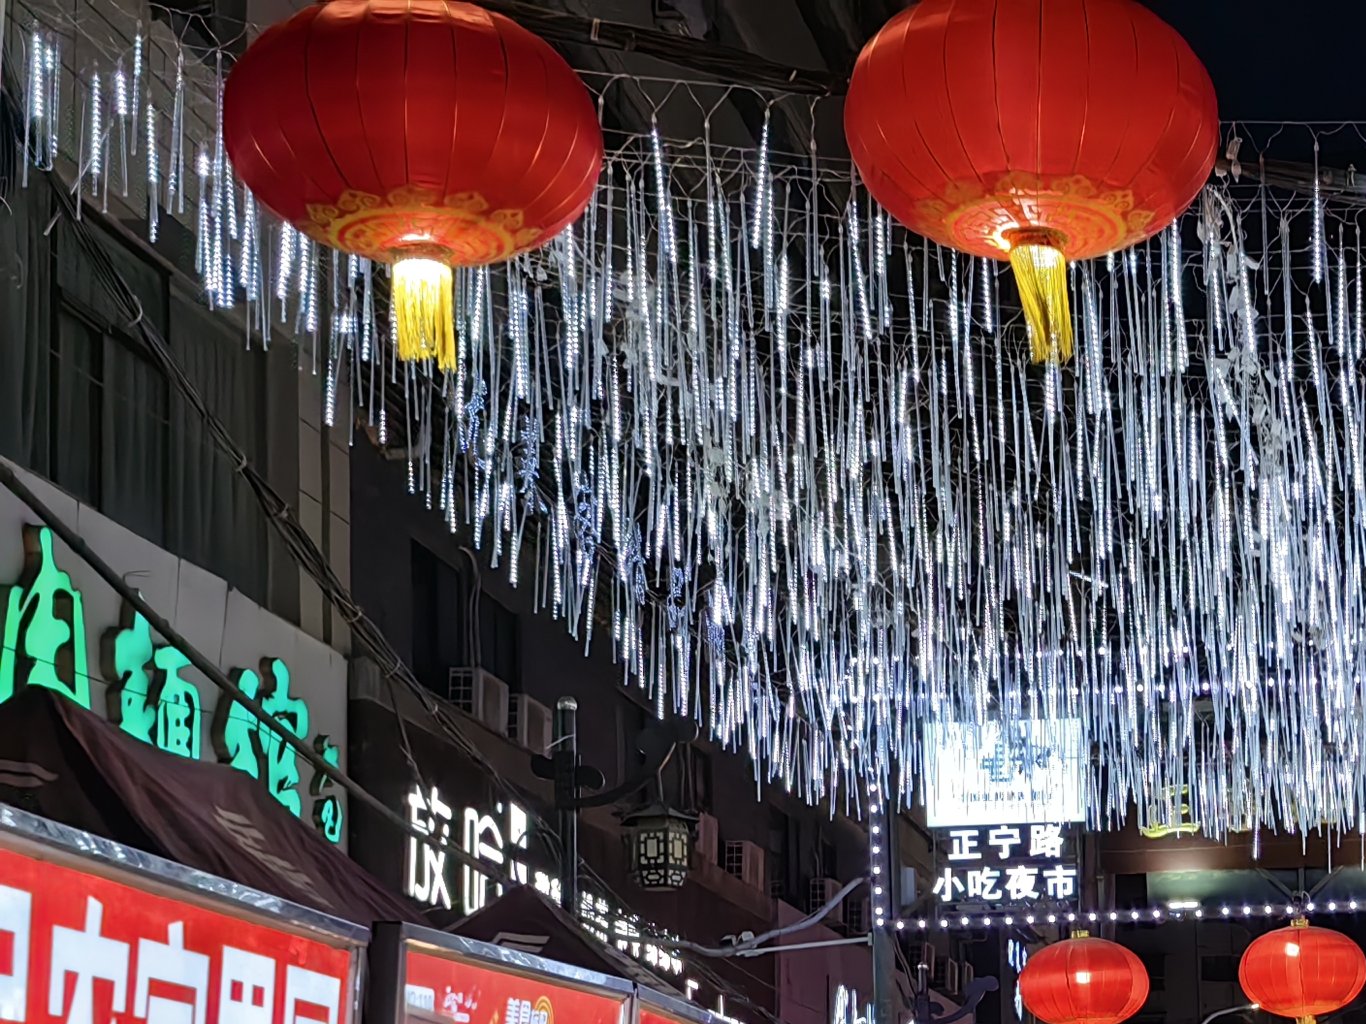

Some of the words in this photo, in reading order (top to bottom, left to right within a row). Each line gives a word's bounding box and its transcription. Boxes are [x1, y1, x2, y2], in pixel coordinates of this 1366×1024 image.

[948, 824, 1064, 861] 正宁路
[932, 865, 1078, 901] 小吃夜市
